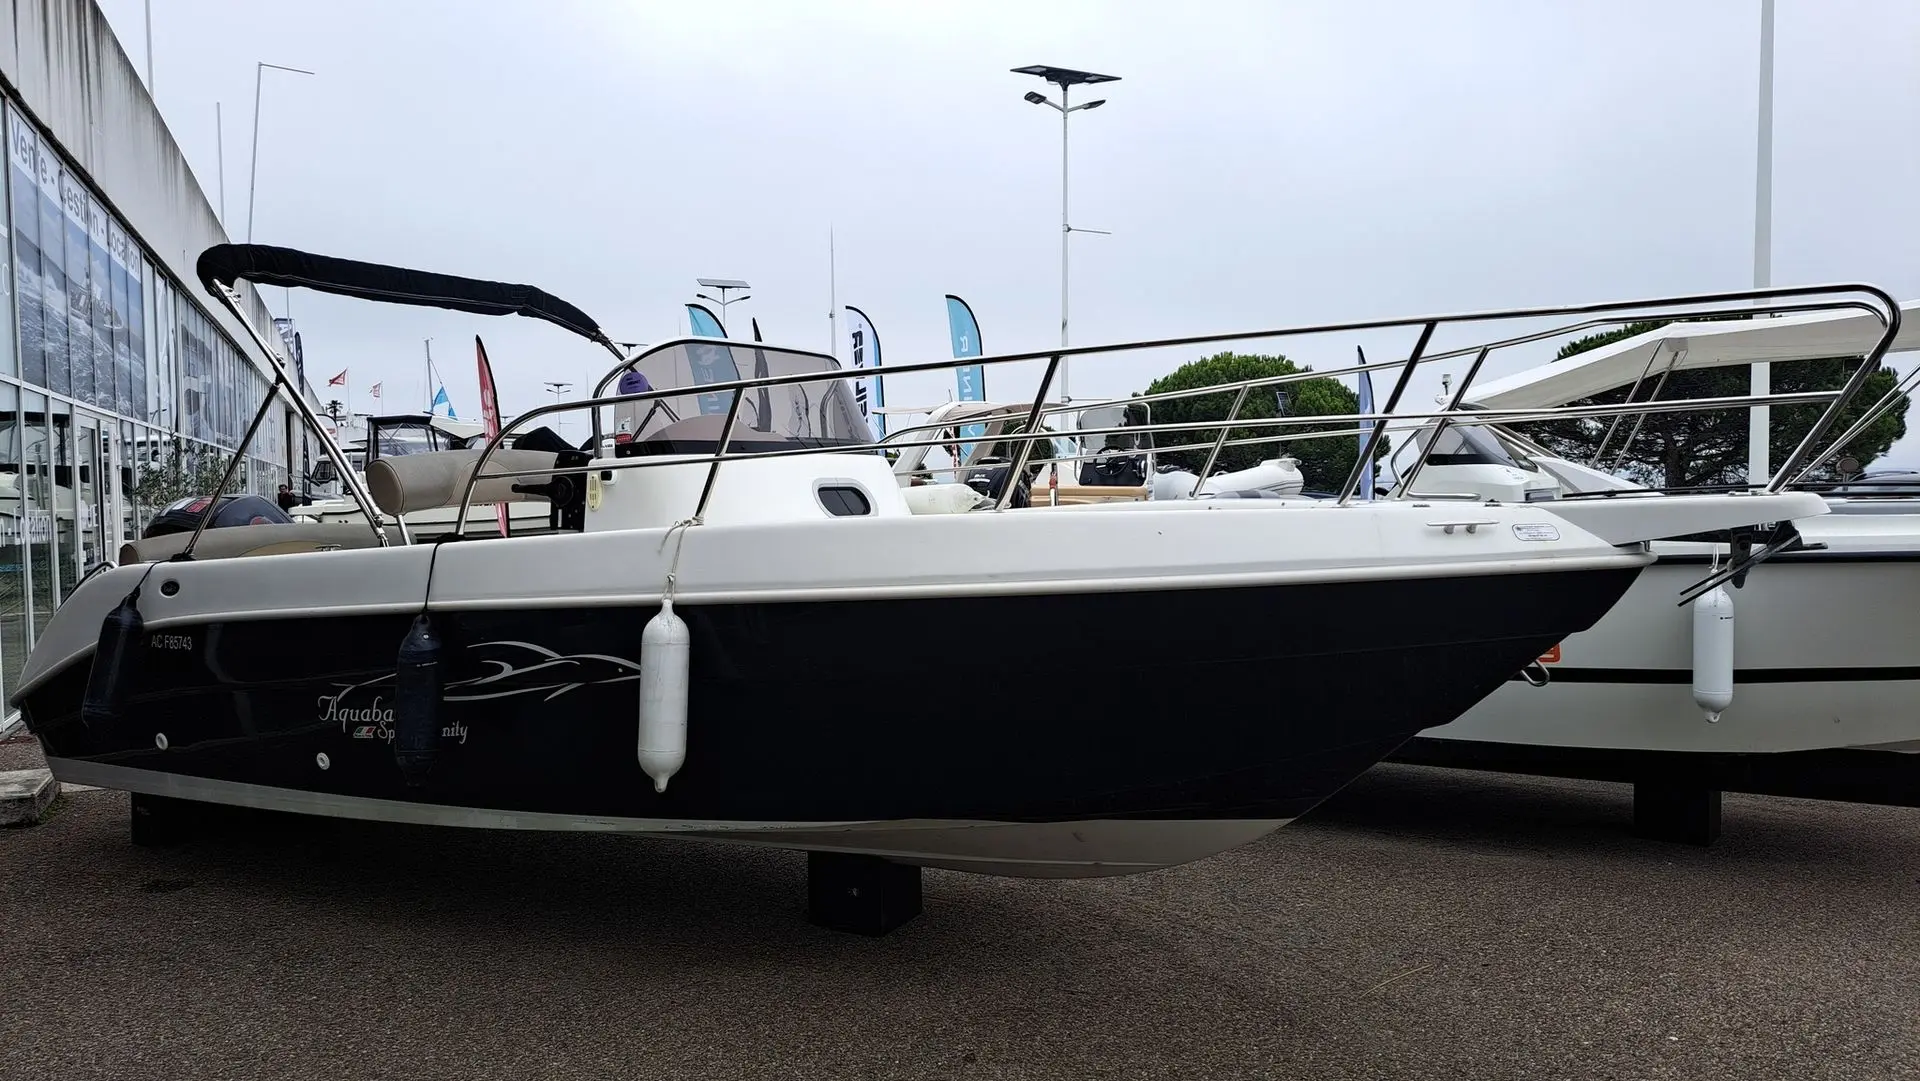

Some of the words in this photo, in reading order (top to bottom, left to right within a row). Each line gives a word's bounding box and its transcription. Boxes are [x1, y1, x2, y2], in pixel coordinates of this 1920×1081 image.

[151, 634, 163, 649] AC
[164, 635, 193, 651] F85743
[318, 695, 395, 733] Aquaba
